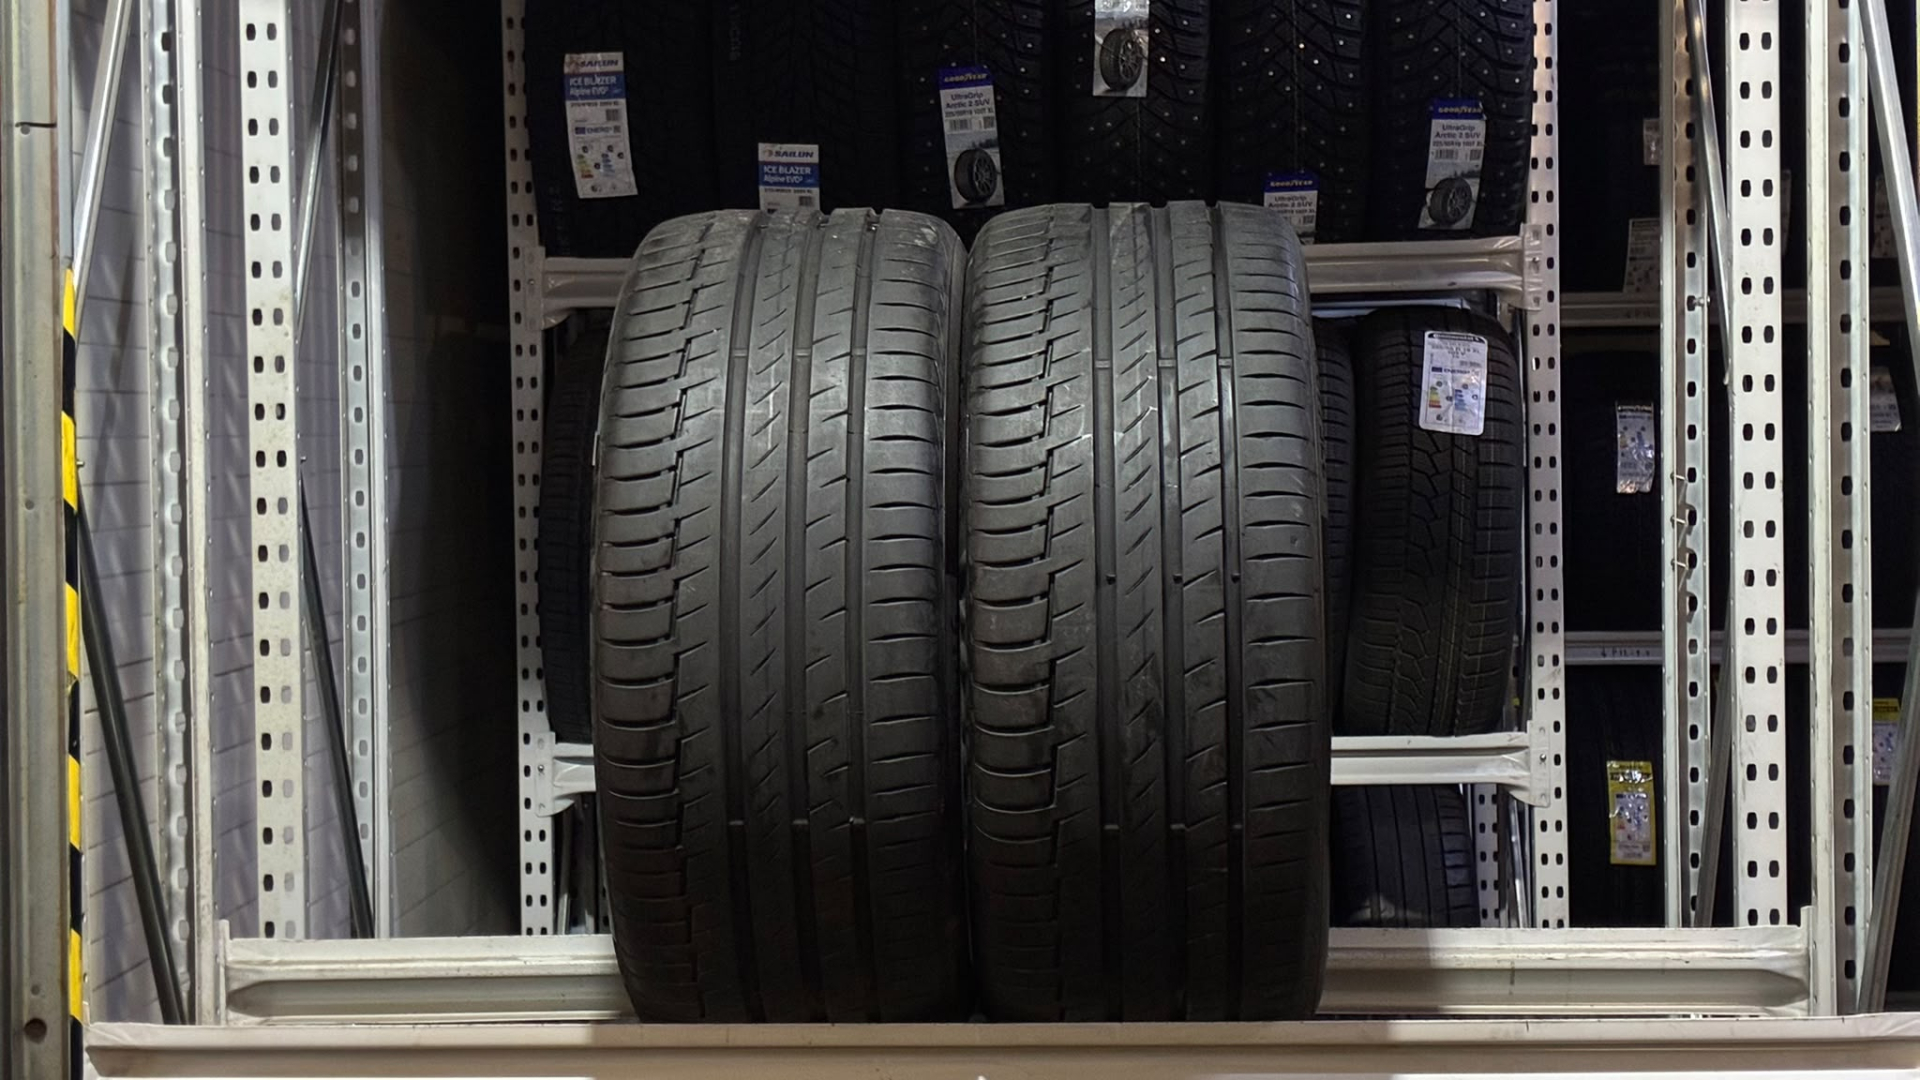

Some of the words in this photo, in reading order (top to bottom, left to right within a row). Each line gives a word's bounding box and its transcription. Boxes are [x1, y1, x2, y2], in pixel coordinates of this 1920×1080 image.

[569, 76, 583, 87] ICE
[584, 75, 617, 87] BLAZER
[951, 91, 984, 101] UltraGrip
[974, 98, 990, 107] SUV
[1442, 123, 1476, 132] UltraGrip
[1435, 131, 1457, 139] Arctic
[1465, 131, 1481, 139] SUV
[774, 150, 814, 158] SAILUN
[763, 164, 778, 174] ICE
[779, 165, 811, 175] BLAZER
[763, 174, 785, 184] Alpine
[1275, 195, 1307, 203] UltraGrip
